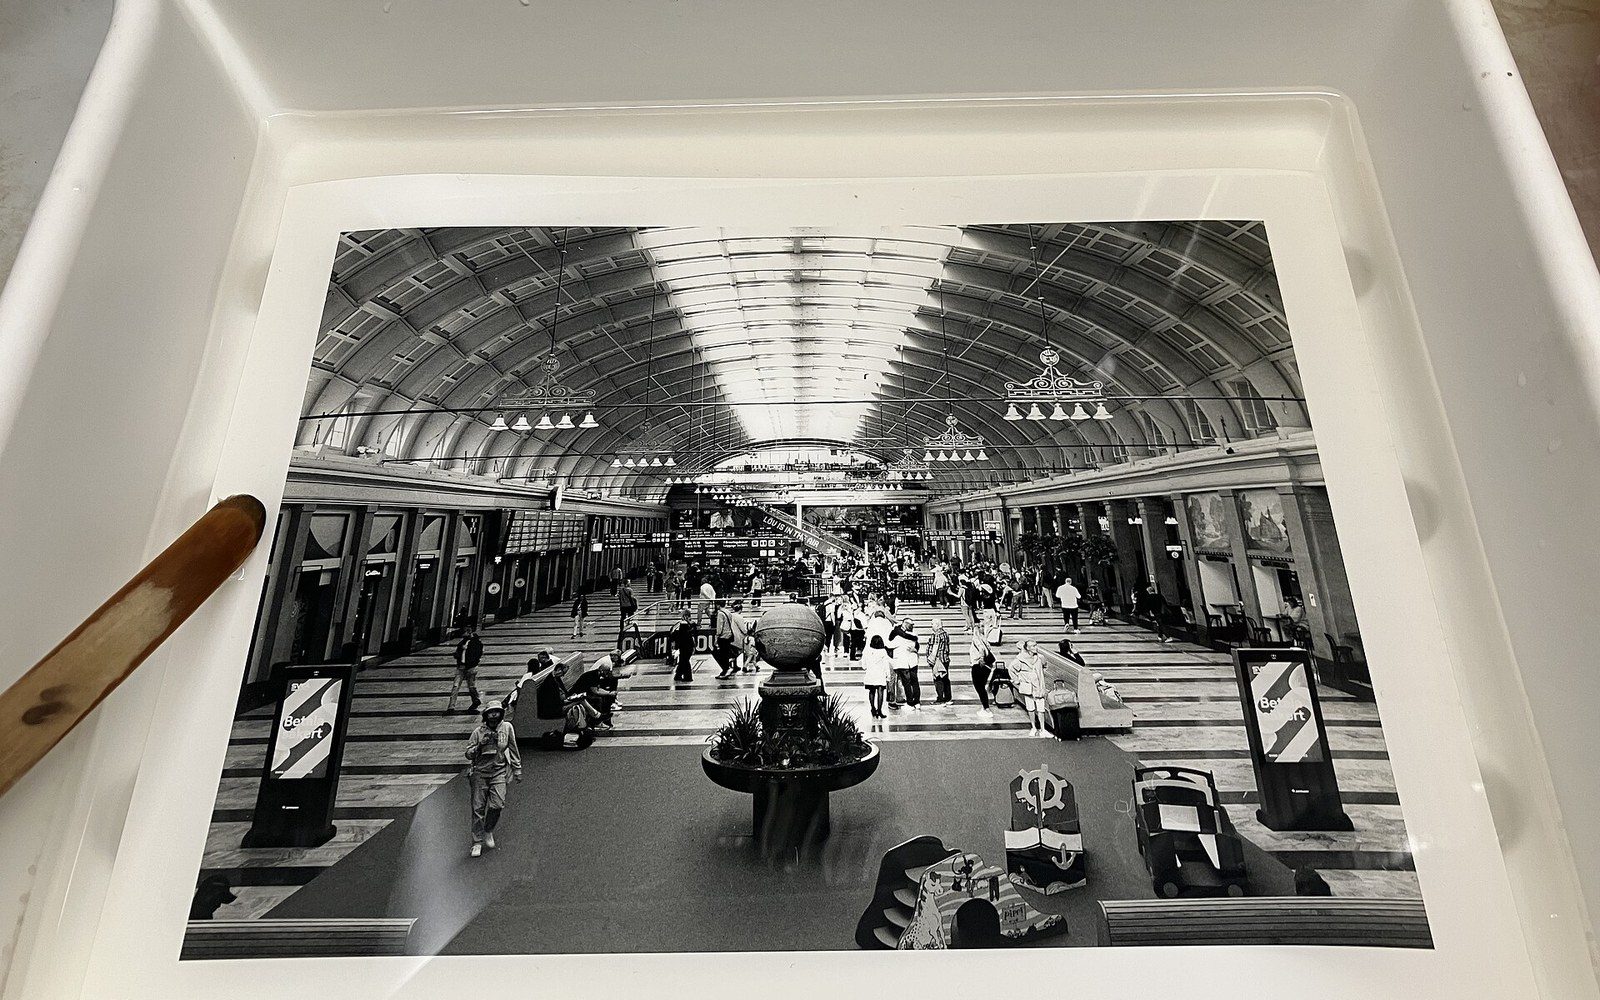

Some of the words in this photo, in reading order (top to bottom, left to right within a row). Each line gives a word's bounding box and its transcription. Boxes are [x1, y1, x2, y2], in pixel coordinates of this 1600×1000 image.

[763, 516, 778, 527] LOU
[776, 523, 785, 531] IS
[784, 527, 794, 535] IN
[806, 538, 820, 548] AIR
